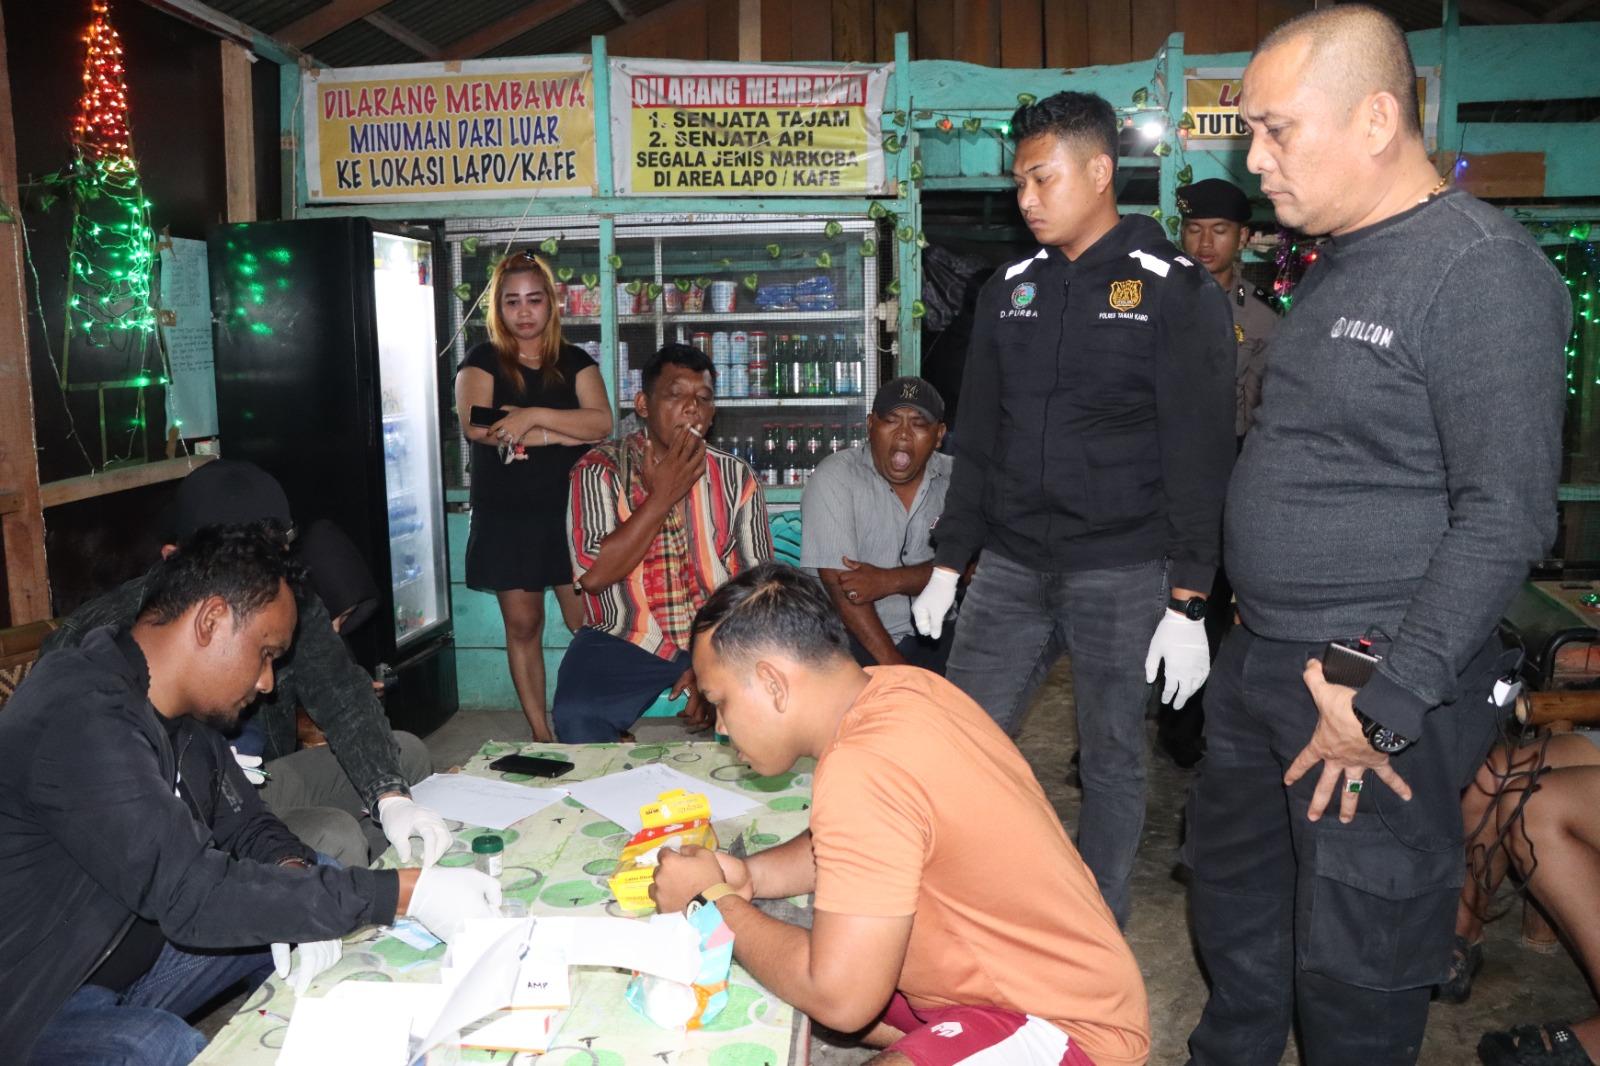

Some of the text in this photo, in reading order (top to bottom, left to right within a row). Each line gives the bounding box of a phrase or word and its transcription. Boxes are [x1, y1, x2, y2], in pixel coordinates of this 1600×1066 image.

[324, 78, 586, 119] DILARANG MEMBAWA
[635, 77, 865, 105] DILARANG MEMBAWA
[649, 110, 850, 128] 1. SENJATA TAJAM
[350, 115, 560, 153] MINUMAN DARI LUAR
[649, 130, 813, 148] 2. SENJATA API
[336, 150, 576, 189] KE LOKASI LAPO/KAFE
[636, 151, 858, 168] SEGALA JENIS NARKOBA
[654, 171, 671, 187] DI
[676, 170, 725, 187] AREA
[730, 170, 778, 187] LAPO
[793, 170, 840, 187] KAFE
